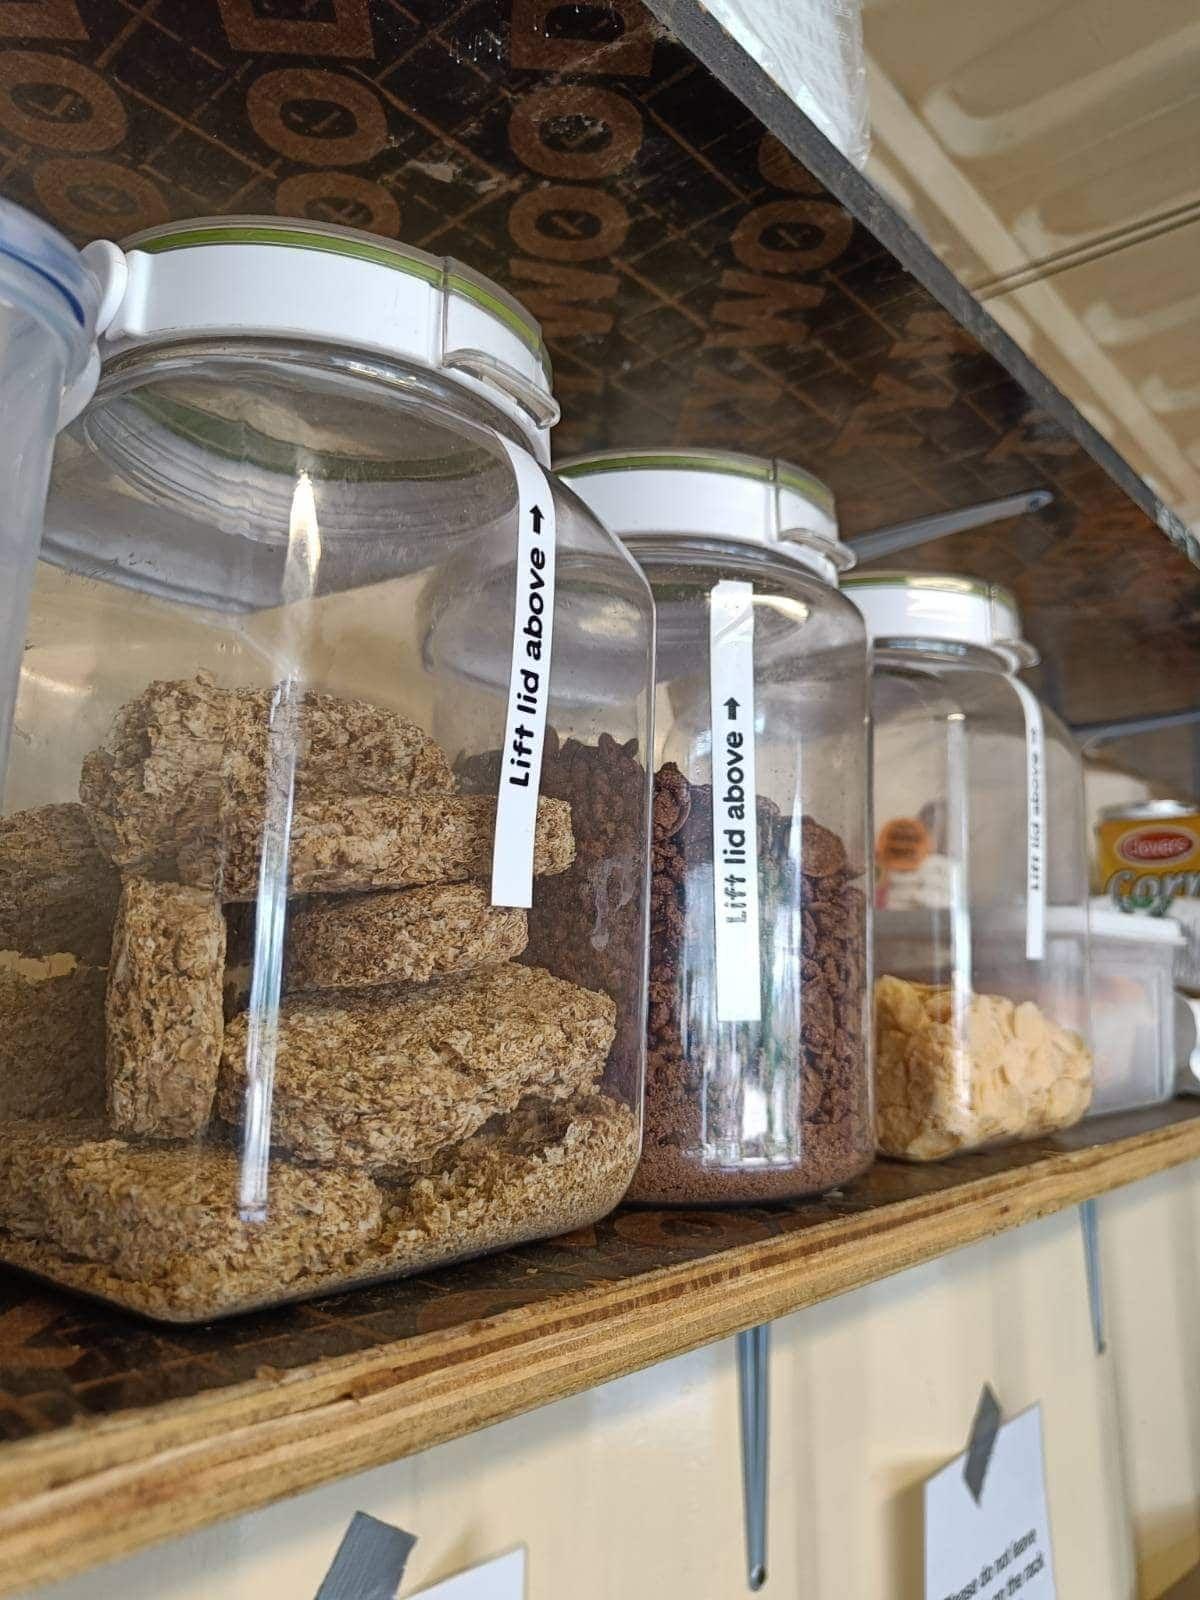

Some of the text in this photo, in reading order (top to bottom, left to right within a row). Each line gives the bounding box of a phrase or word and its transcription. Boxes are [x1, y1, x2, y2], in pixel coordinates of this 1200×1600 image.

[509, 547, 546, 788] Lift lid above
[723, 731, 747, 924] Lift lid above
